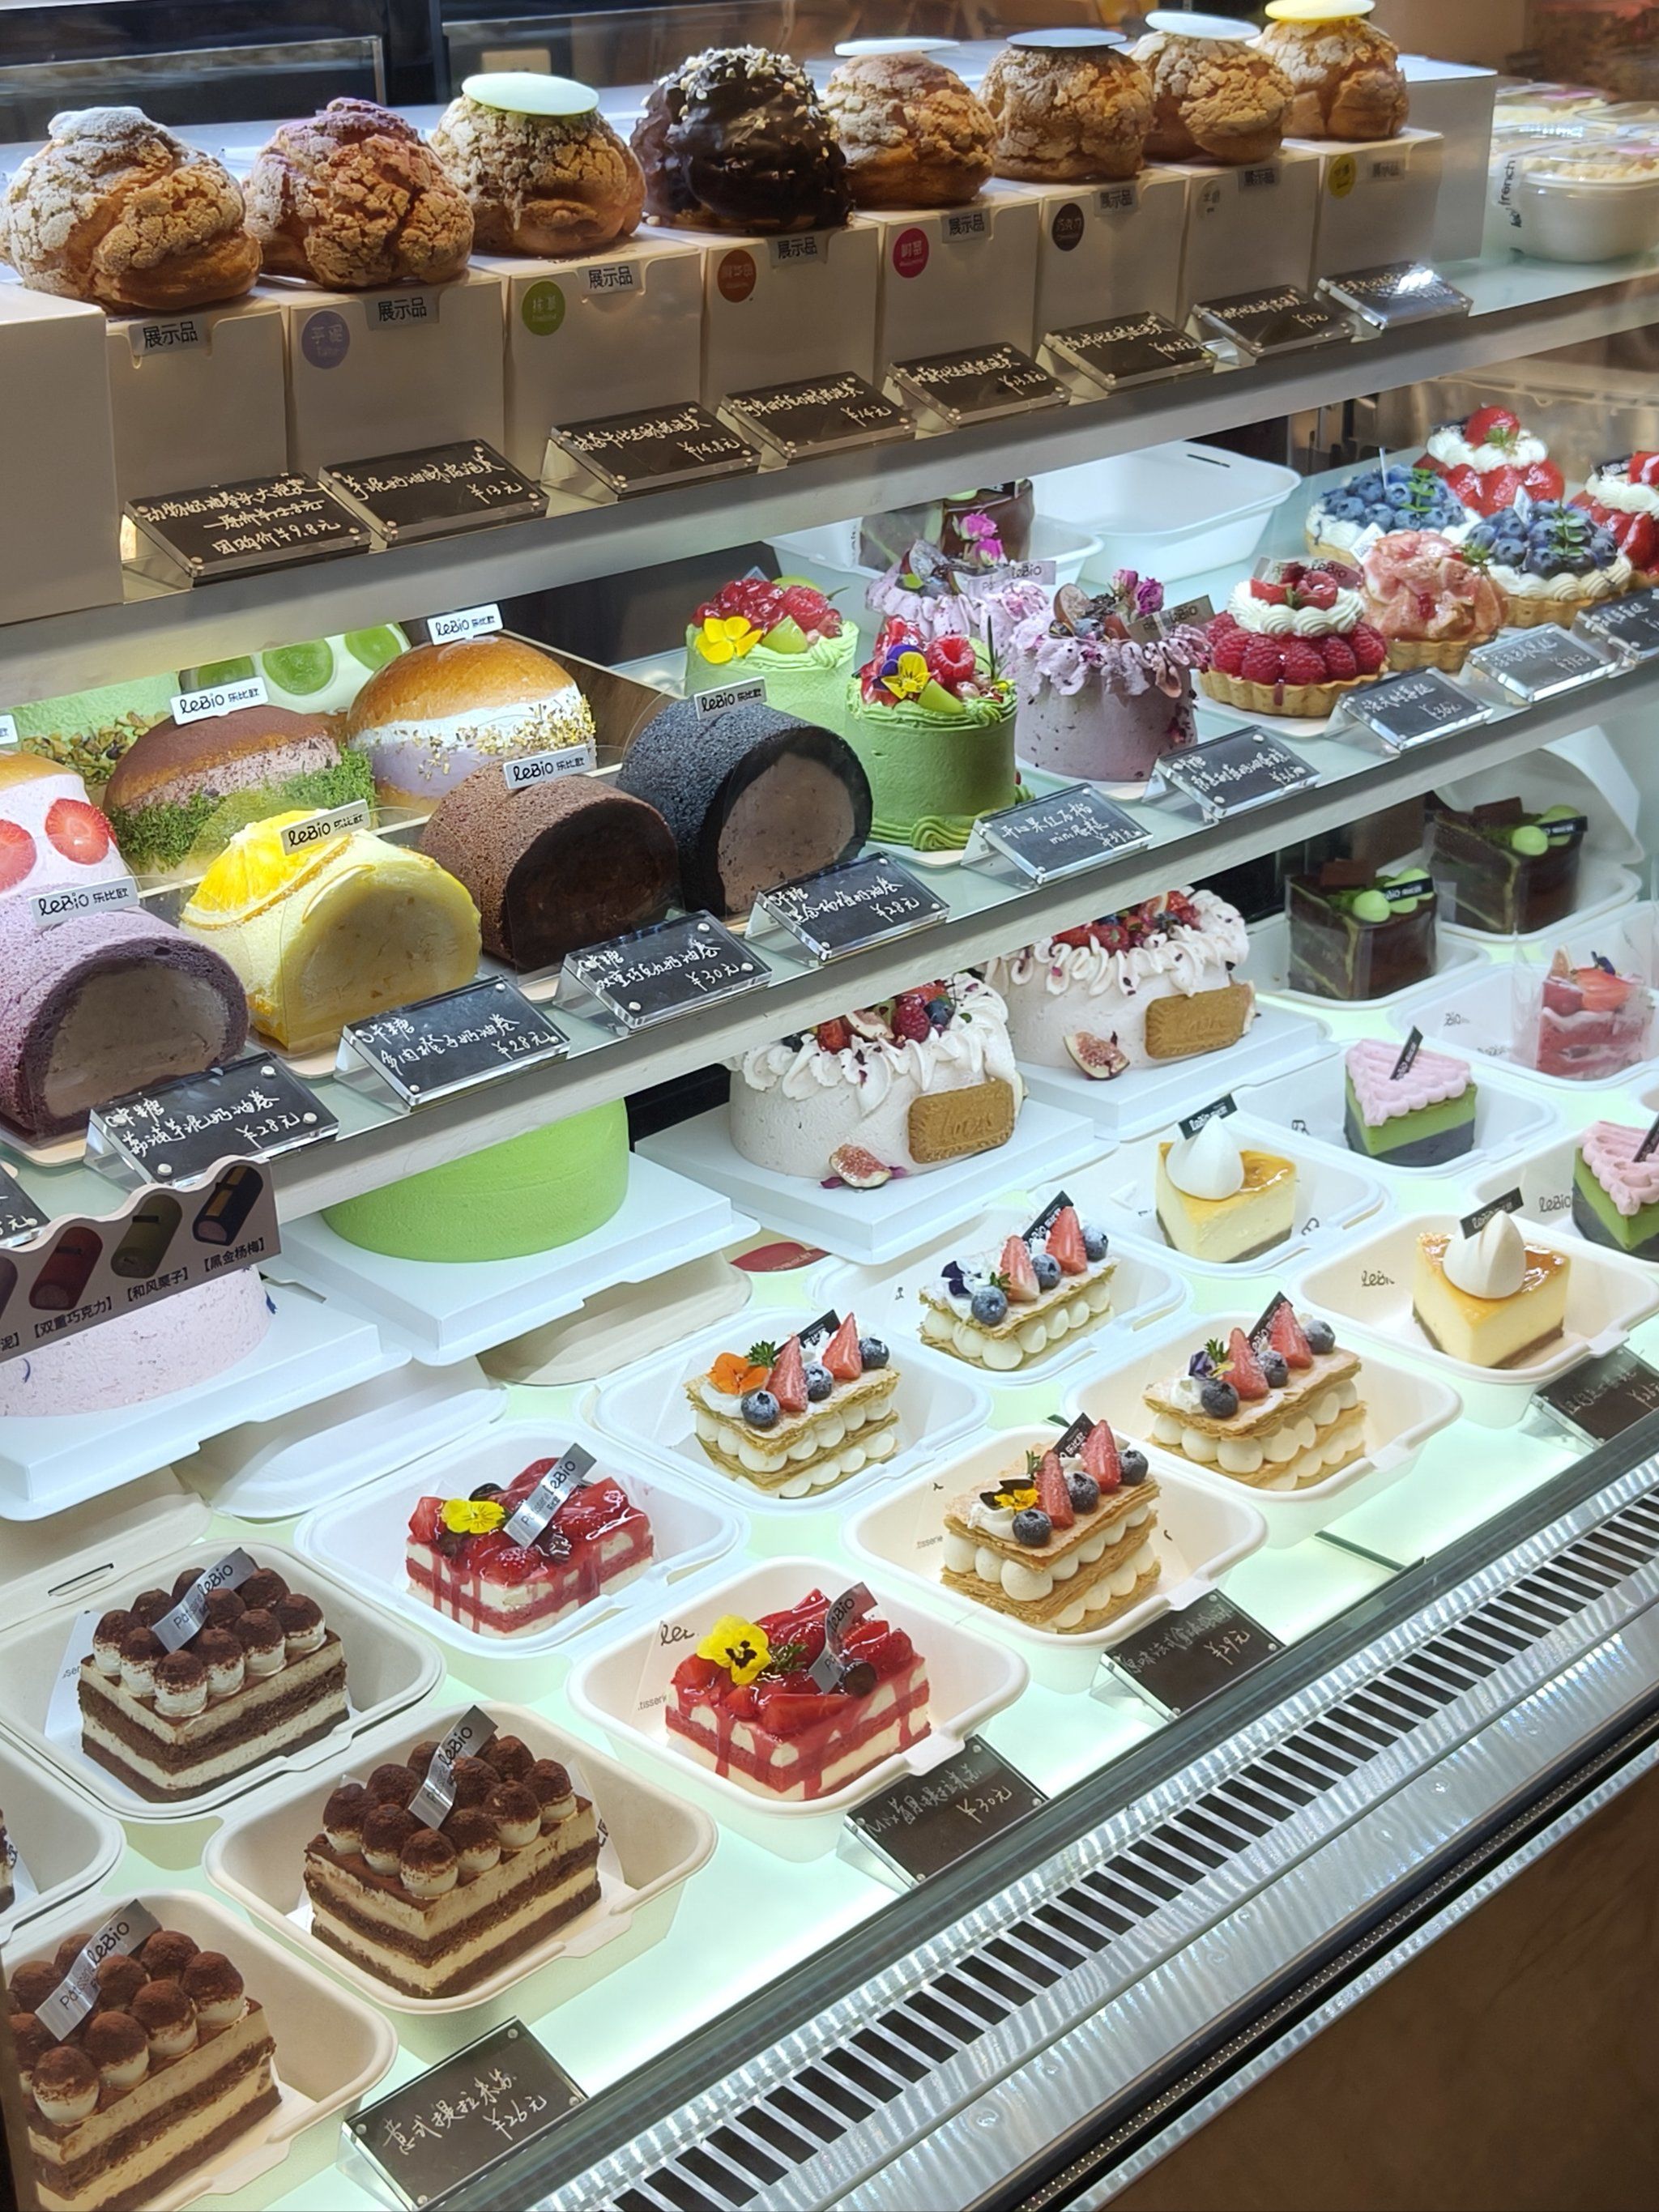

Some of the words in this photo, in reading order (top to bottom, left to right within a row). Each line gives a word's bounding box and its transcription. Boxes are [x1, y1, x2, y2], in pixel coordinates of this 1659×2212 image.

[1099, 189, 1133, 210] 展示品
[949, 212, 985, 237] 展示品
[776, 237, 818, 260] 展示品
[589, 266, 633, 289] 展示品
[378, 296, 428, 322] 展示品
[143, 321, 198, 349] 展示品
[840, 405, 892, 428] ¥14元
[676, 438, 741, 462] ¥14.8元
[466, 480, 523, 505] ¥13元
[212, 518, 341, 555] 团购价¥9.8元
[179, 690, 225, 714] leBio
[701, 693, 735, 713] leBio
[513, 763, 554, 785] leBio
[288, 821, 331, 847] leBio
[38, 893, 89, 917] leBio
[870, 897, 920, 923] ¥28元
[596, 940, 722, 991] 双重巧克力奶油卷
[684, 963, 740, 992] ¥30元
[491, 1031, 552, 1060] ¥28元
[235, 1112, 301, 1149] ¥28元
[203, 1237, 266, 1273] 【黑金杨梅】
[126, 1267, 189, 1302] 【和风栗子】
[33, 1297, 113, 1339] 【双重巧克力】
[196, 1563, 234, 1596] leBio
[1203, 1630, 1250, 1666] ¥29元
[437, 1725, 473, 1767] leBio
[956, 1784, 1013, 1825] ¥30元
[87, 1921, 130, 1964] leBio
[382, 2068, 516, 2155] 意式提拉米苏
[483, 2095, 548, 2142] ¥26元
